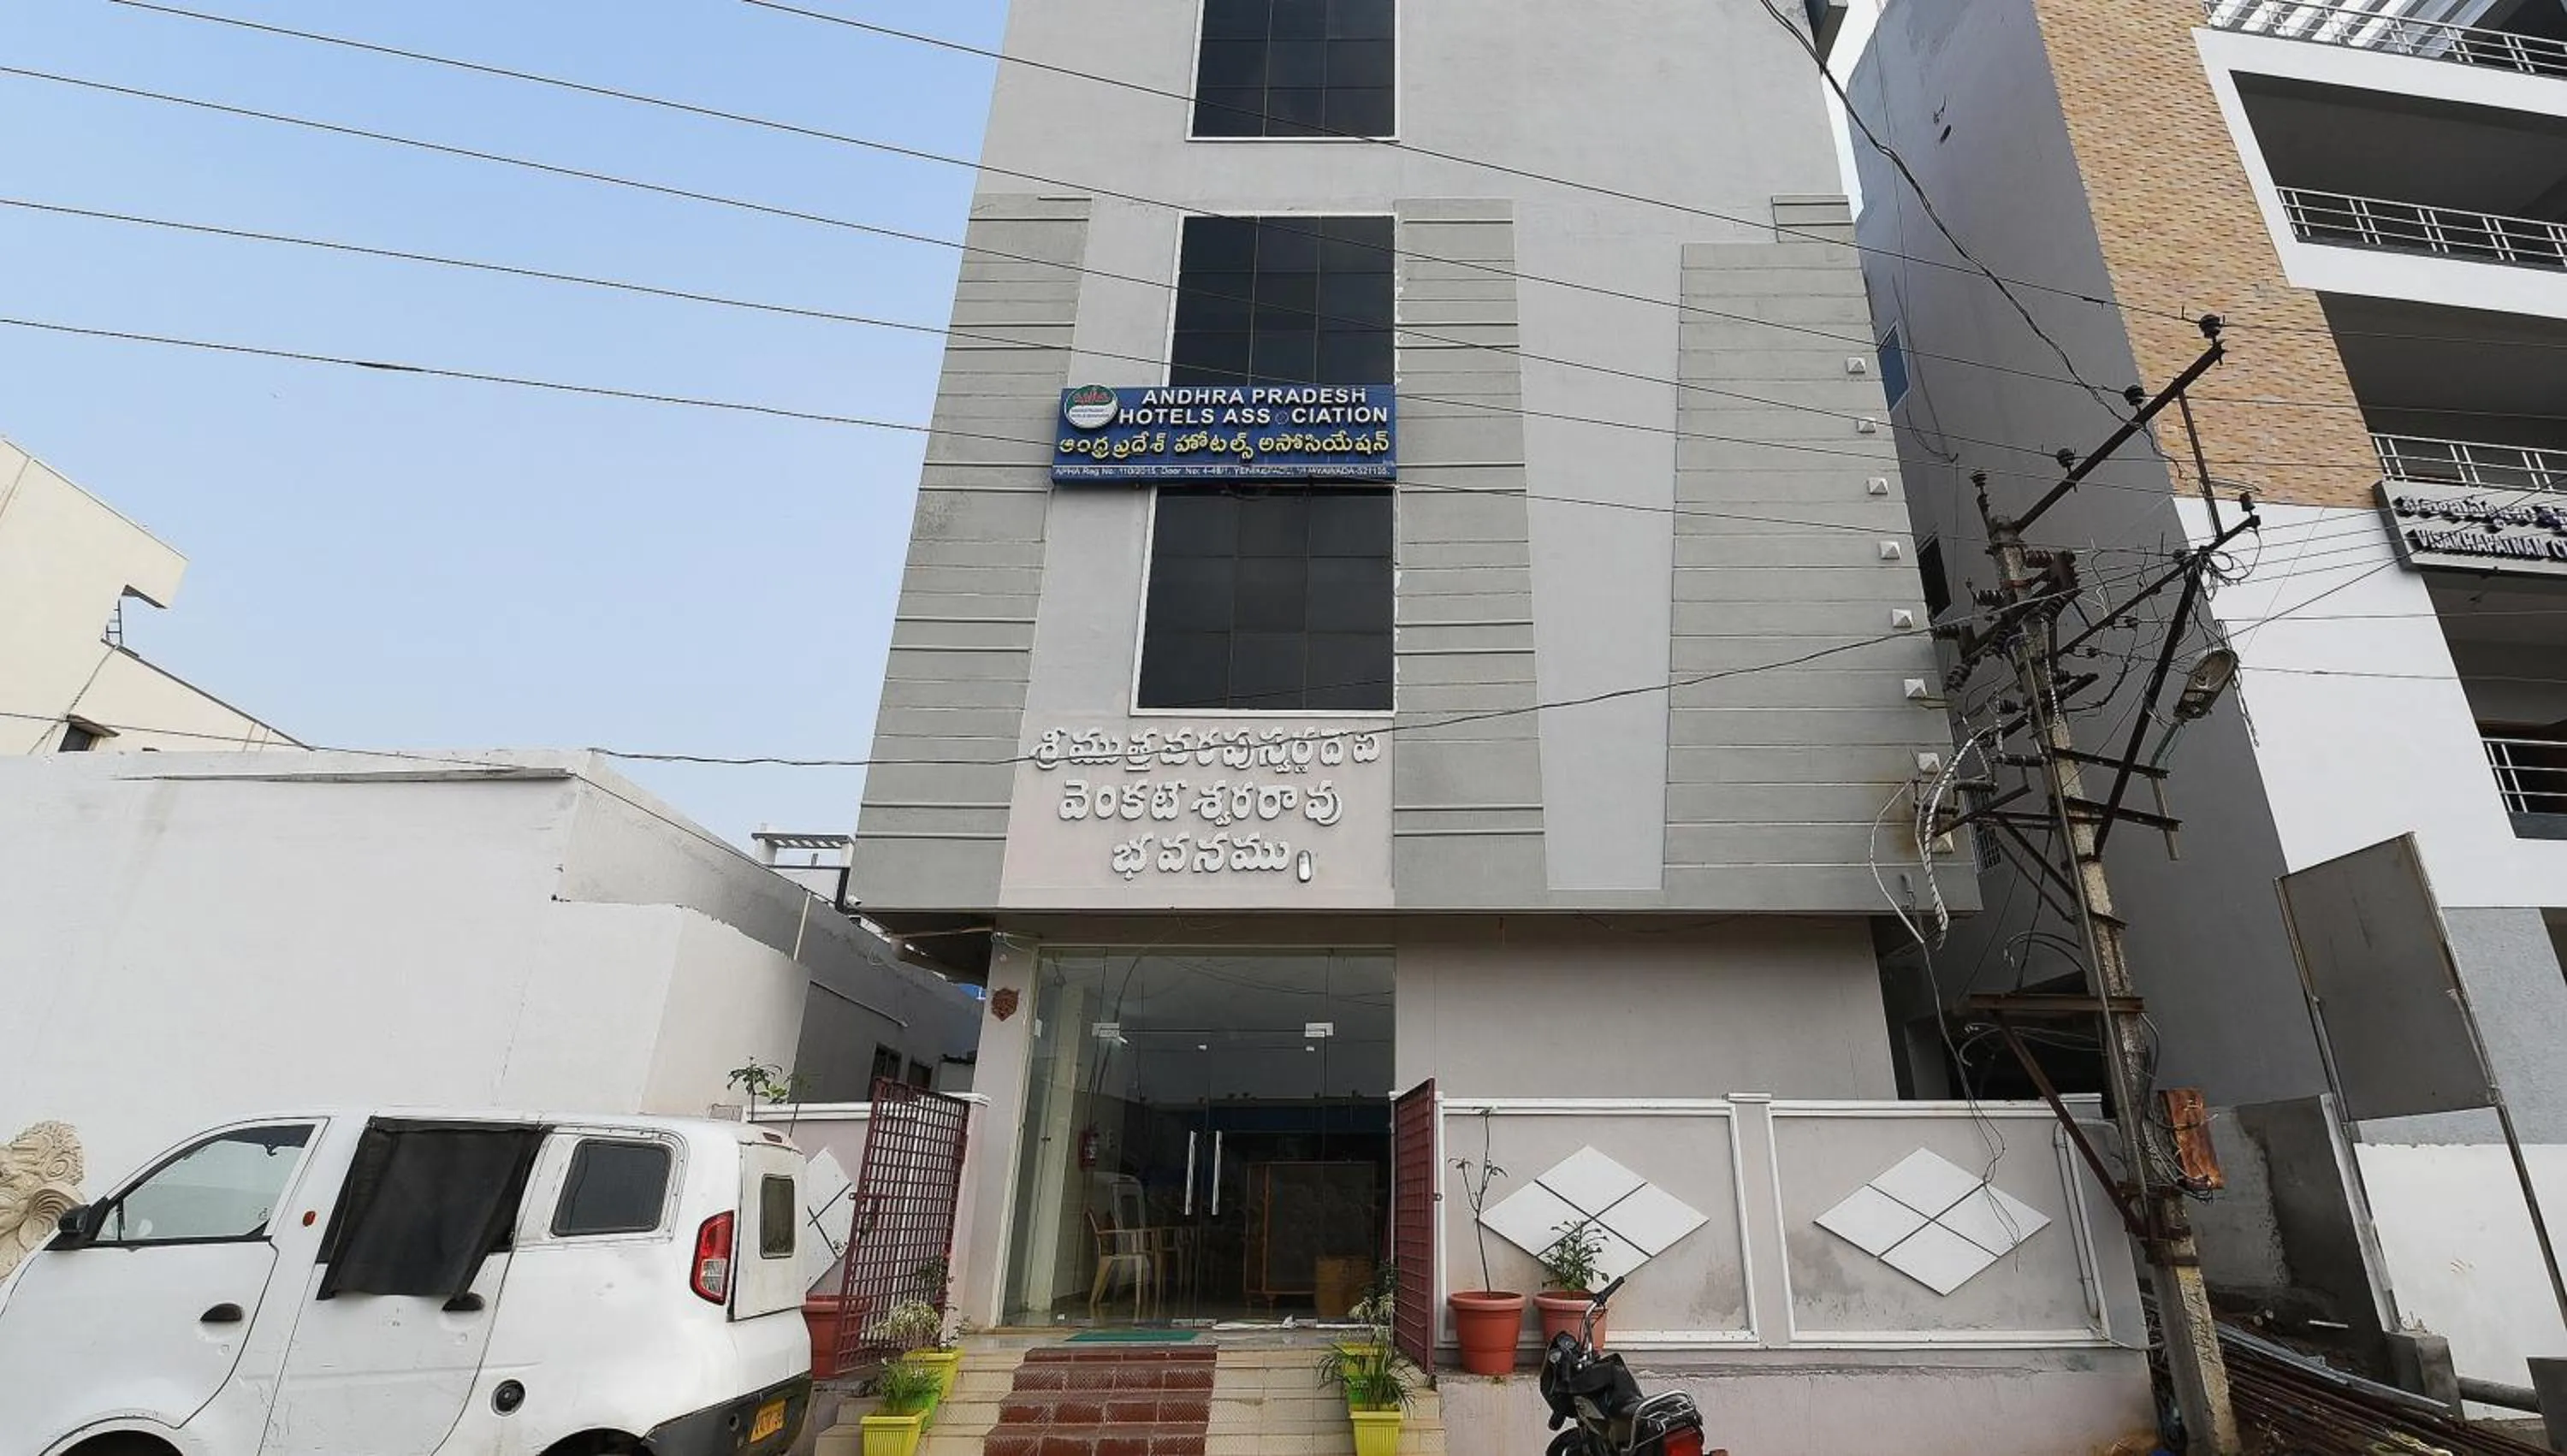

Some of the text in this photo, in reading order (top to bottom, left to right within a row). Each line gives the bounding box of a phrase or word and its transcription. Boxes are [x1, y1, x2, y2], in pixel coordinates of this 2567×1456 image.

[1141, 387, 1367, 405] ANDHRA PRADESH
[1118, 407, 1215, 425] HOTELS
[1173, 429, 1254, 459] హోటల్స్
[1259, 429, 1390, 455] అసోసియేషన్
[2416, 528, 2551, 558] VISAKHAPATNAM
